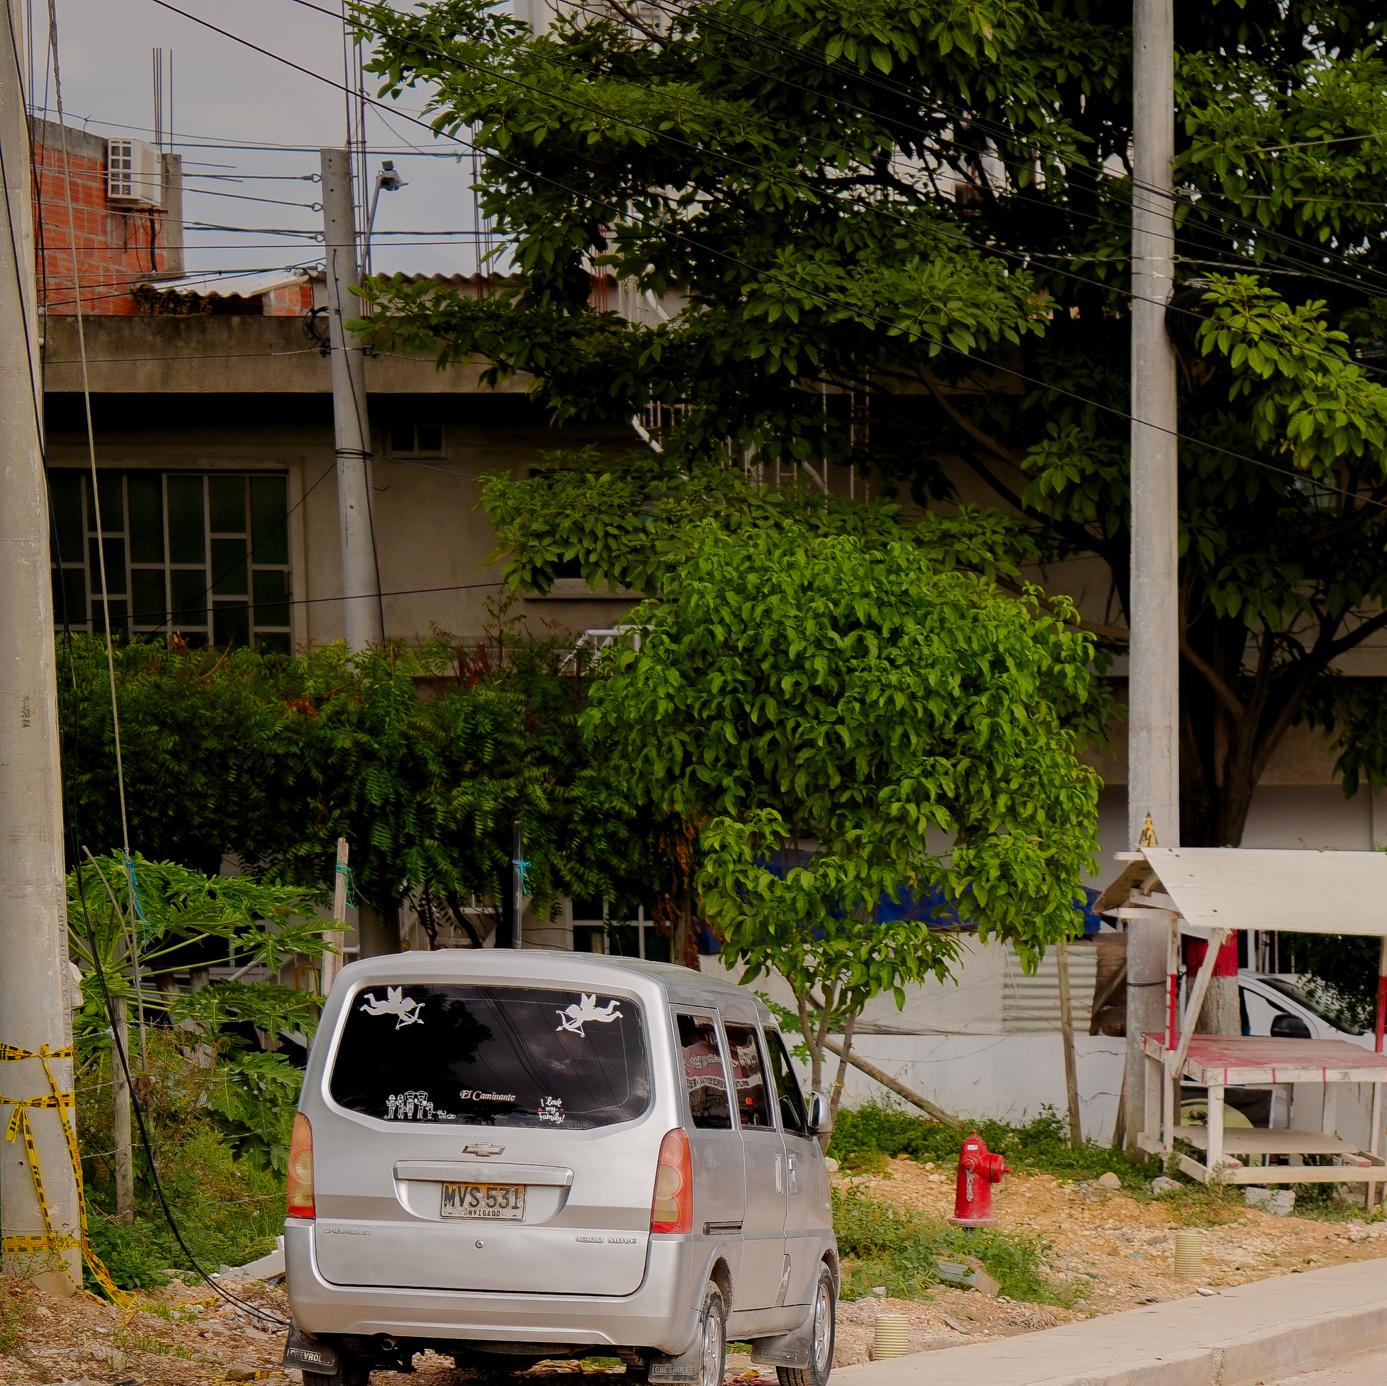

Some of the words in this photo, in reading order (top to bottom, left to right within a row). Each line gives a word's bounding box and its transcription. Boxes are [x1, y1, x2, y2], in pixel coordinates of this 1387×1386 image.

[460, 1089, 472, 1099] El
[472, 1090, 517, 1102] Caminante
[546, 1096, 562, 1108] love
